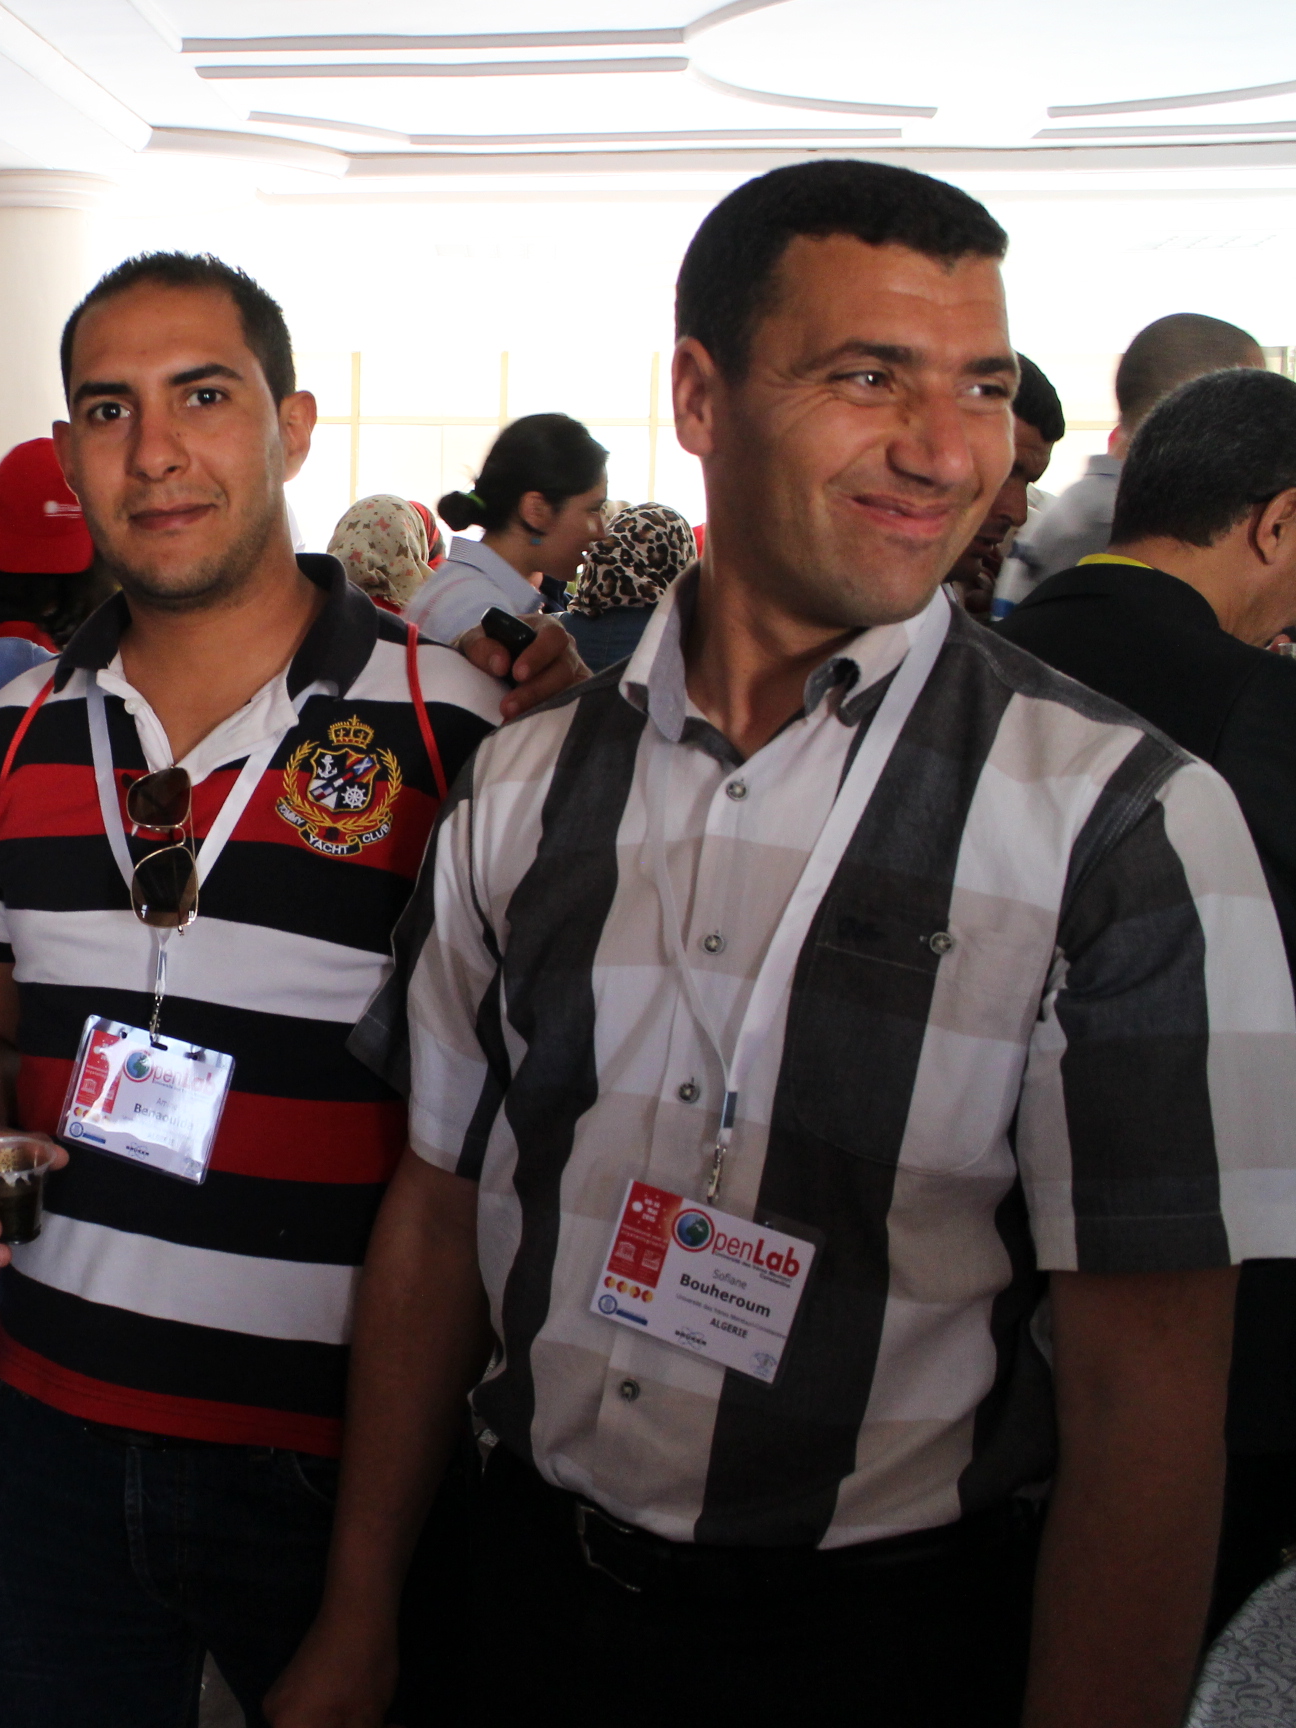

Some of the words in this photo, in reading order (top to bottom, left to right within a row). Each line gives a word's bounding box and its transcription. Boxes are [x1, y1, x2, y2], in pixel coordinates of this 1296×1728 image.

[308, 834, 350, 855] YACHT
[362, 823, 390, 843] CLUB
[671, 1208, 801, 1278] OpenLab
[712, 1268, 748, 1289] Sofiane
[679, 1273, 772, 1318] Bouheroum
[709, 1317, 748, 1339] ALGERIE
